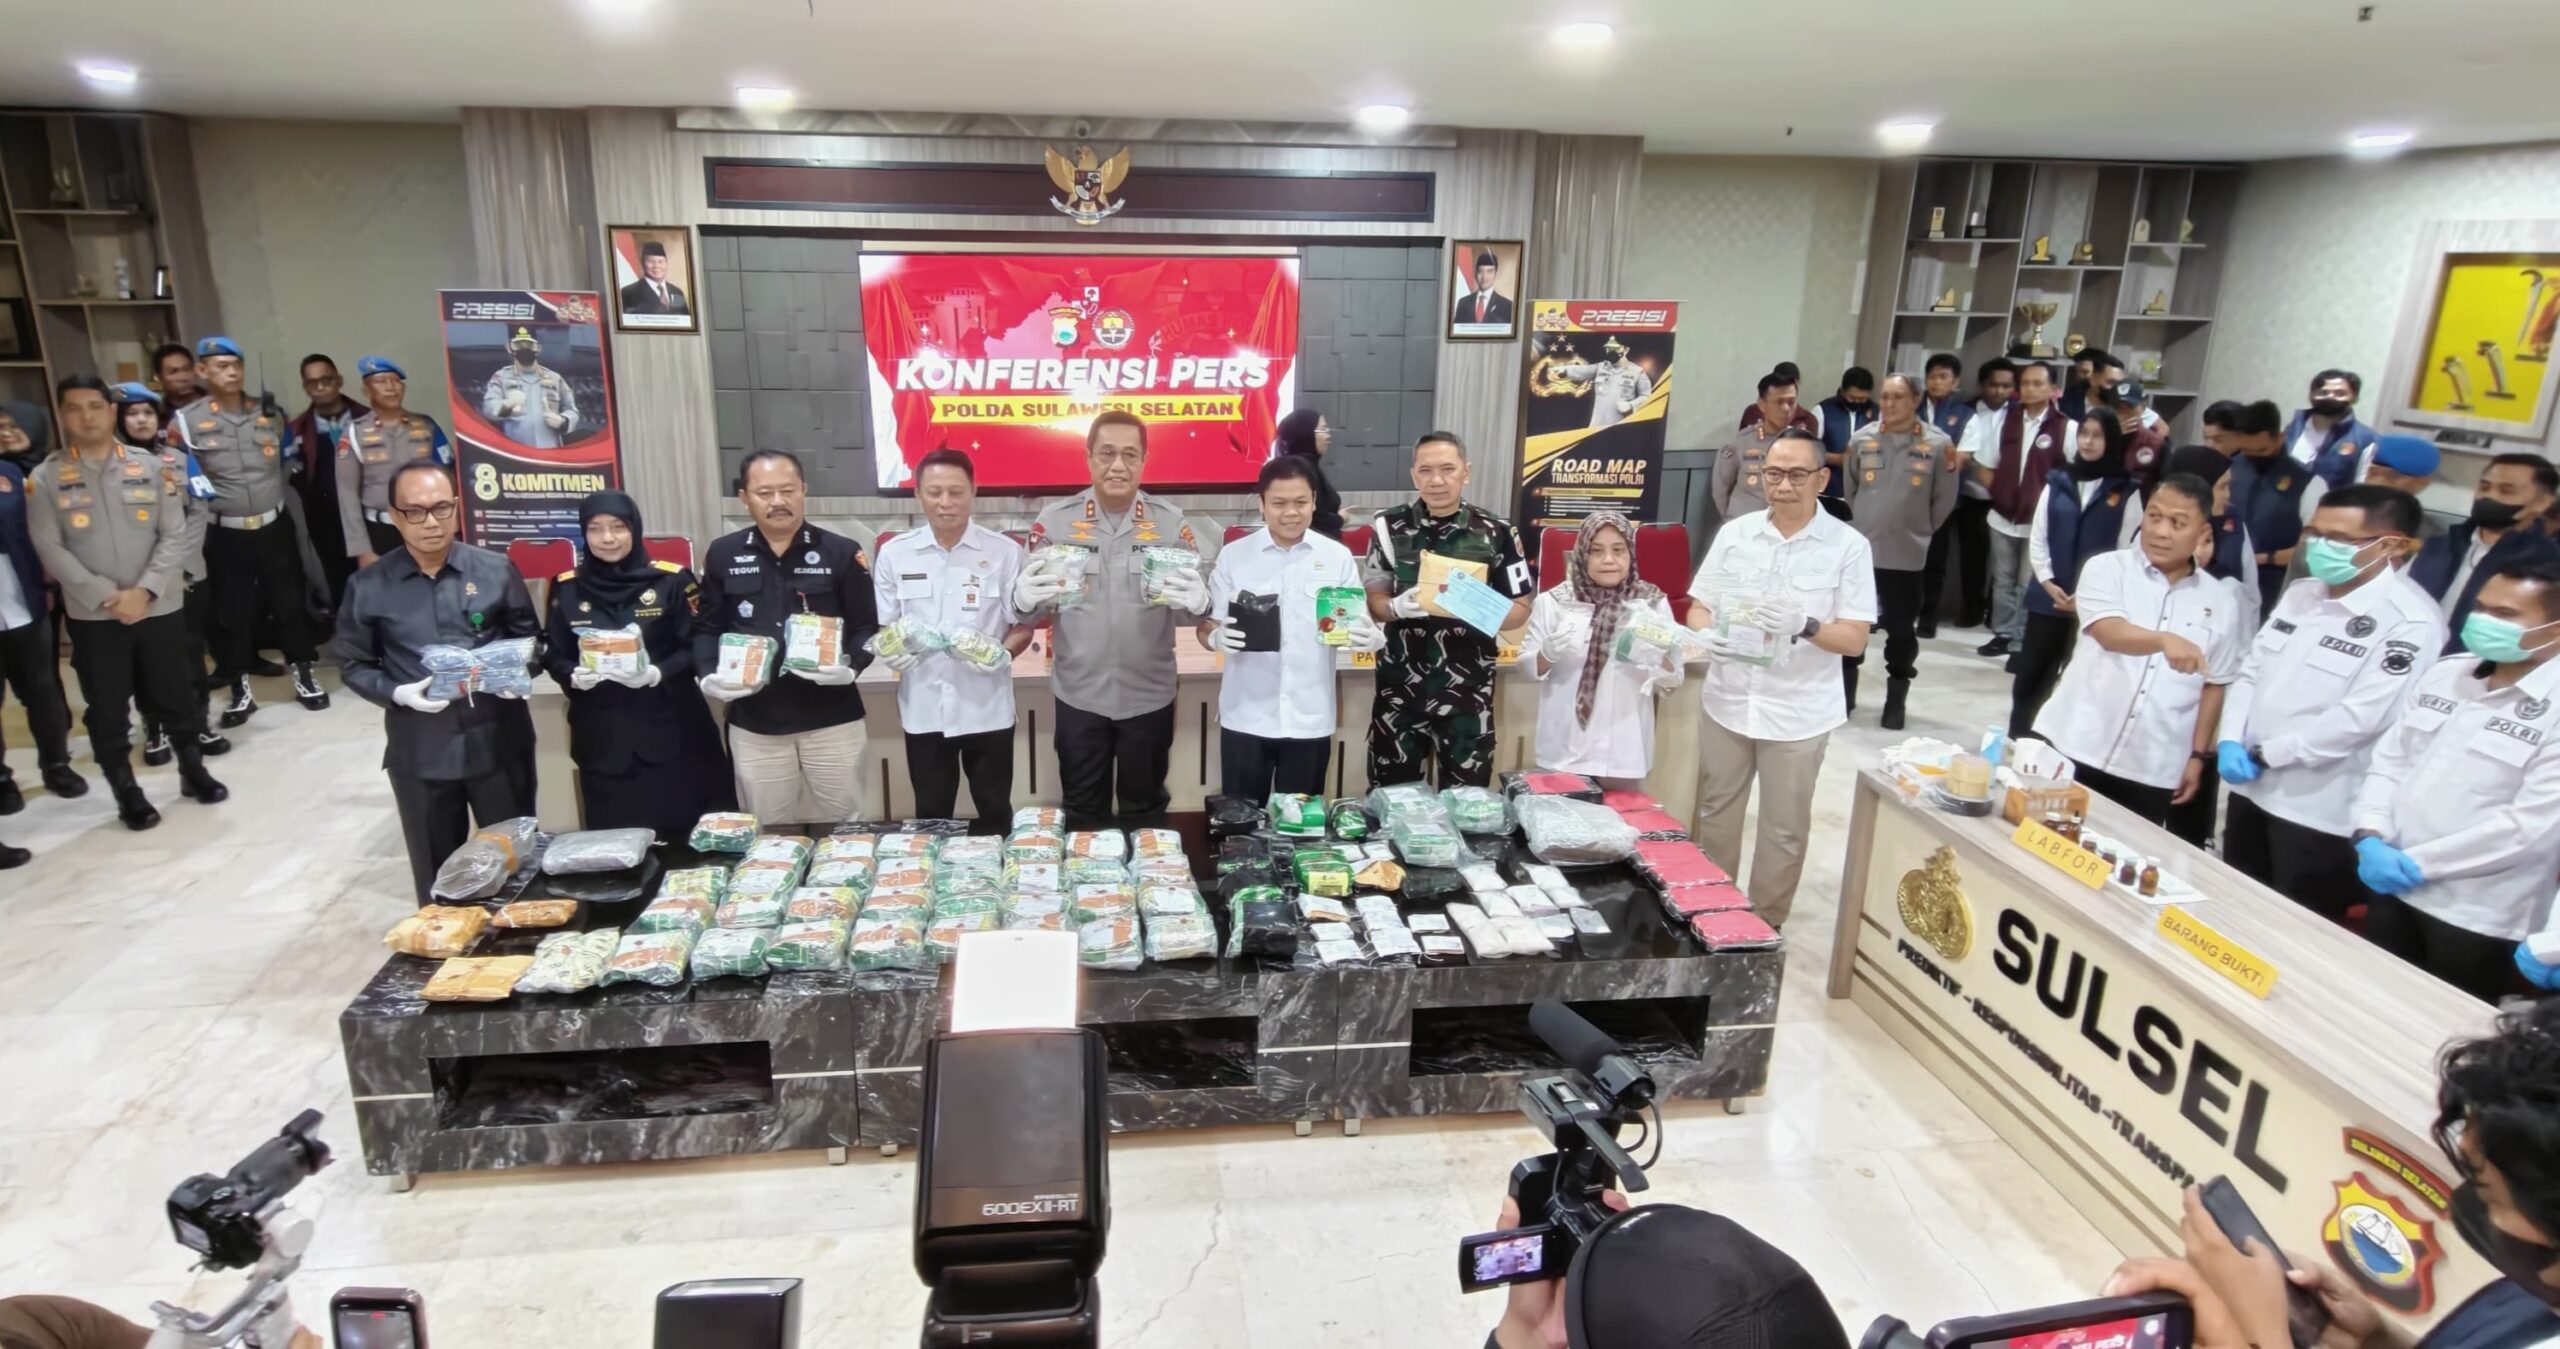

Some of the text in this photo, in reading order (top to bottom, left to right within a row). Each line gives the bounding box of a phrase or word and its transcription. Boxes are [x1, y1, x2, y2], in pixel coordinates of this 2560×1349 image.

[453, 302, 535, 316] PRESISI
[1580, 309, 1668, 323] PRESISI
[896, 357, 1272, 391] KONFERENSI PERS
[942, 404, 1014, 418] POLDA
[1140, 402, 1234, 416] SELATAN
[1551, 458, 1647, 474] ROAD MAP
[474, 463, 605, 501] 8 KOMITMEN
[1552, 473, 1645, 485] TRANSFORMASI POLRI
[2489, 718, 2538, 741] POLRI
[2027, 830, 2099, 877] LABFOR
[2162, 915, 2264, 986] BARANG BUKTI
[1993, 908, 2288, 1195] SULSEL
